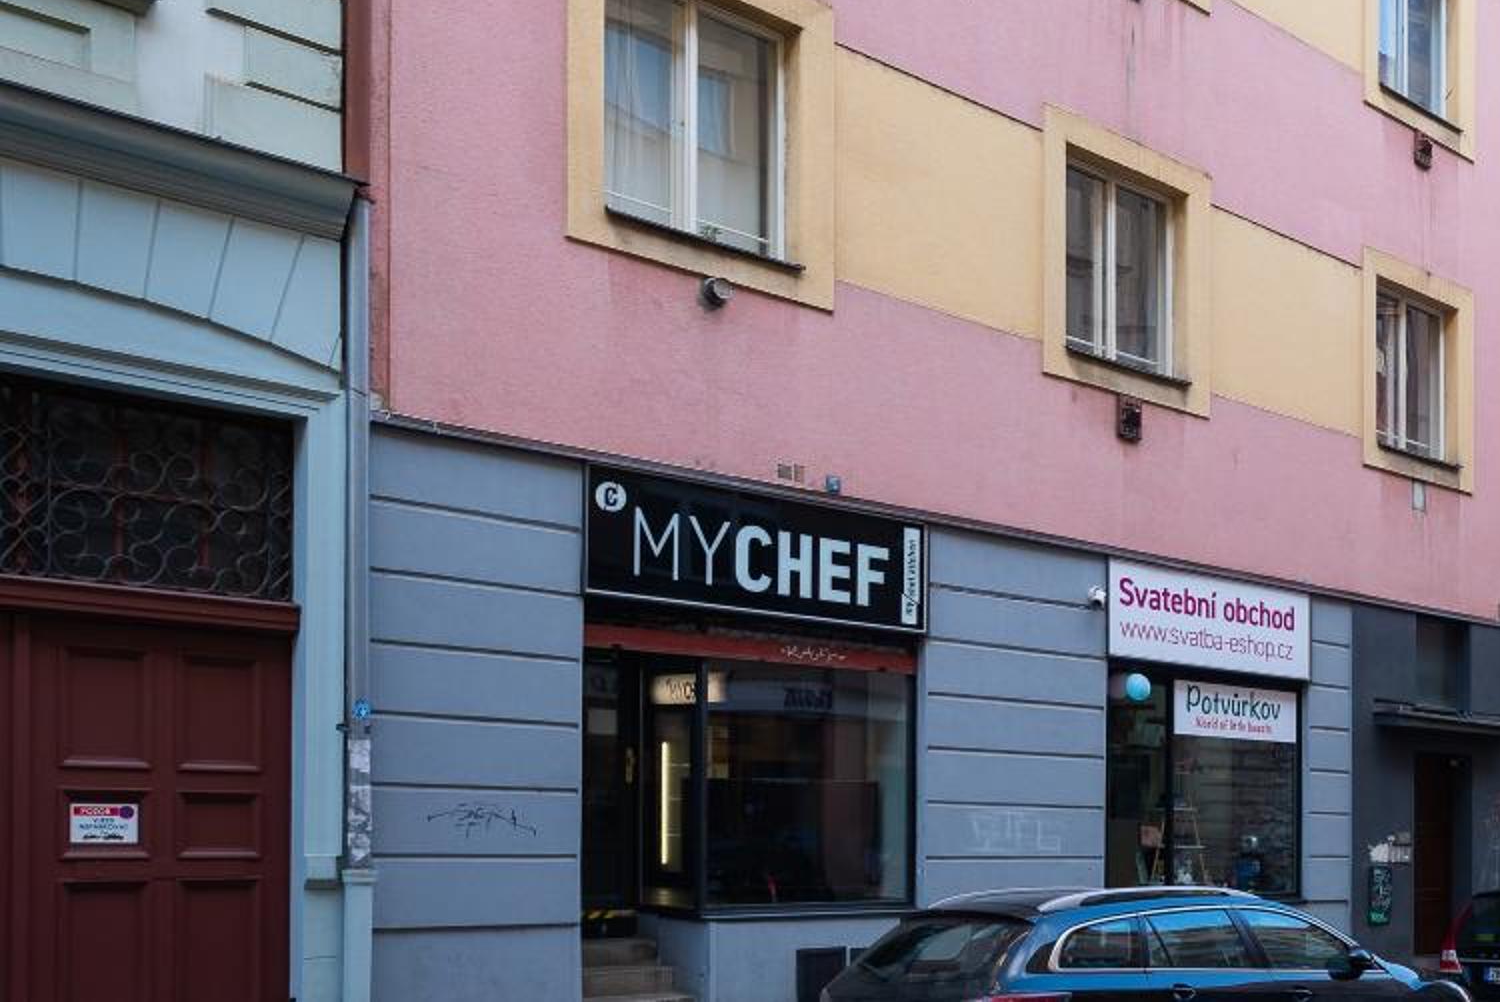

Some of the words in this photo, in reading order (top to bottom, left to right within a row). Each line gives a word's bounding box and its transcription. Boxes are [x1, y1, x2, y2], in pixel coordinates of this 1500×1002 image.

[633, 505, 889, 608] MYCHEF
[1119, 577, 1217, 619] Svatební
[1223, 598, 1295, 631] obchod
[1119, 620, 1294, 661] www.svatba-eshop.cz
